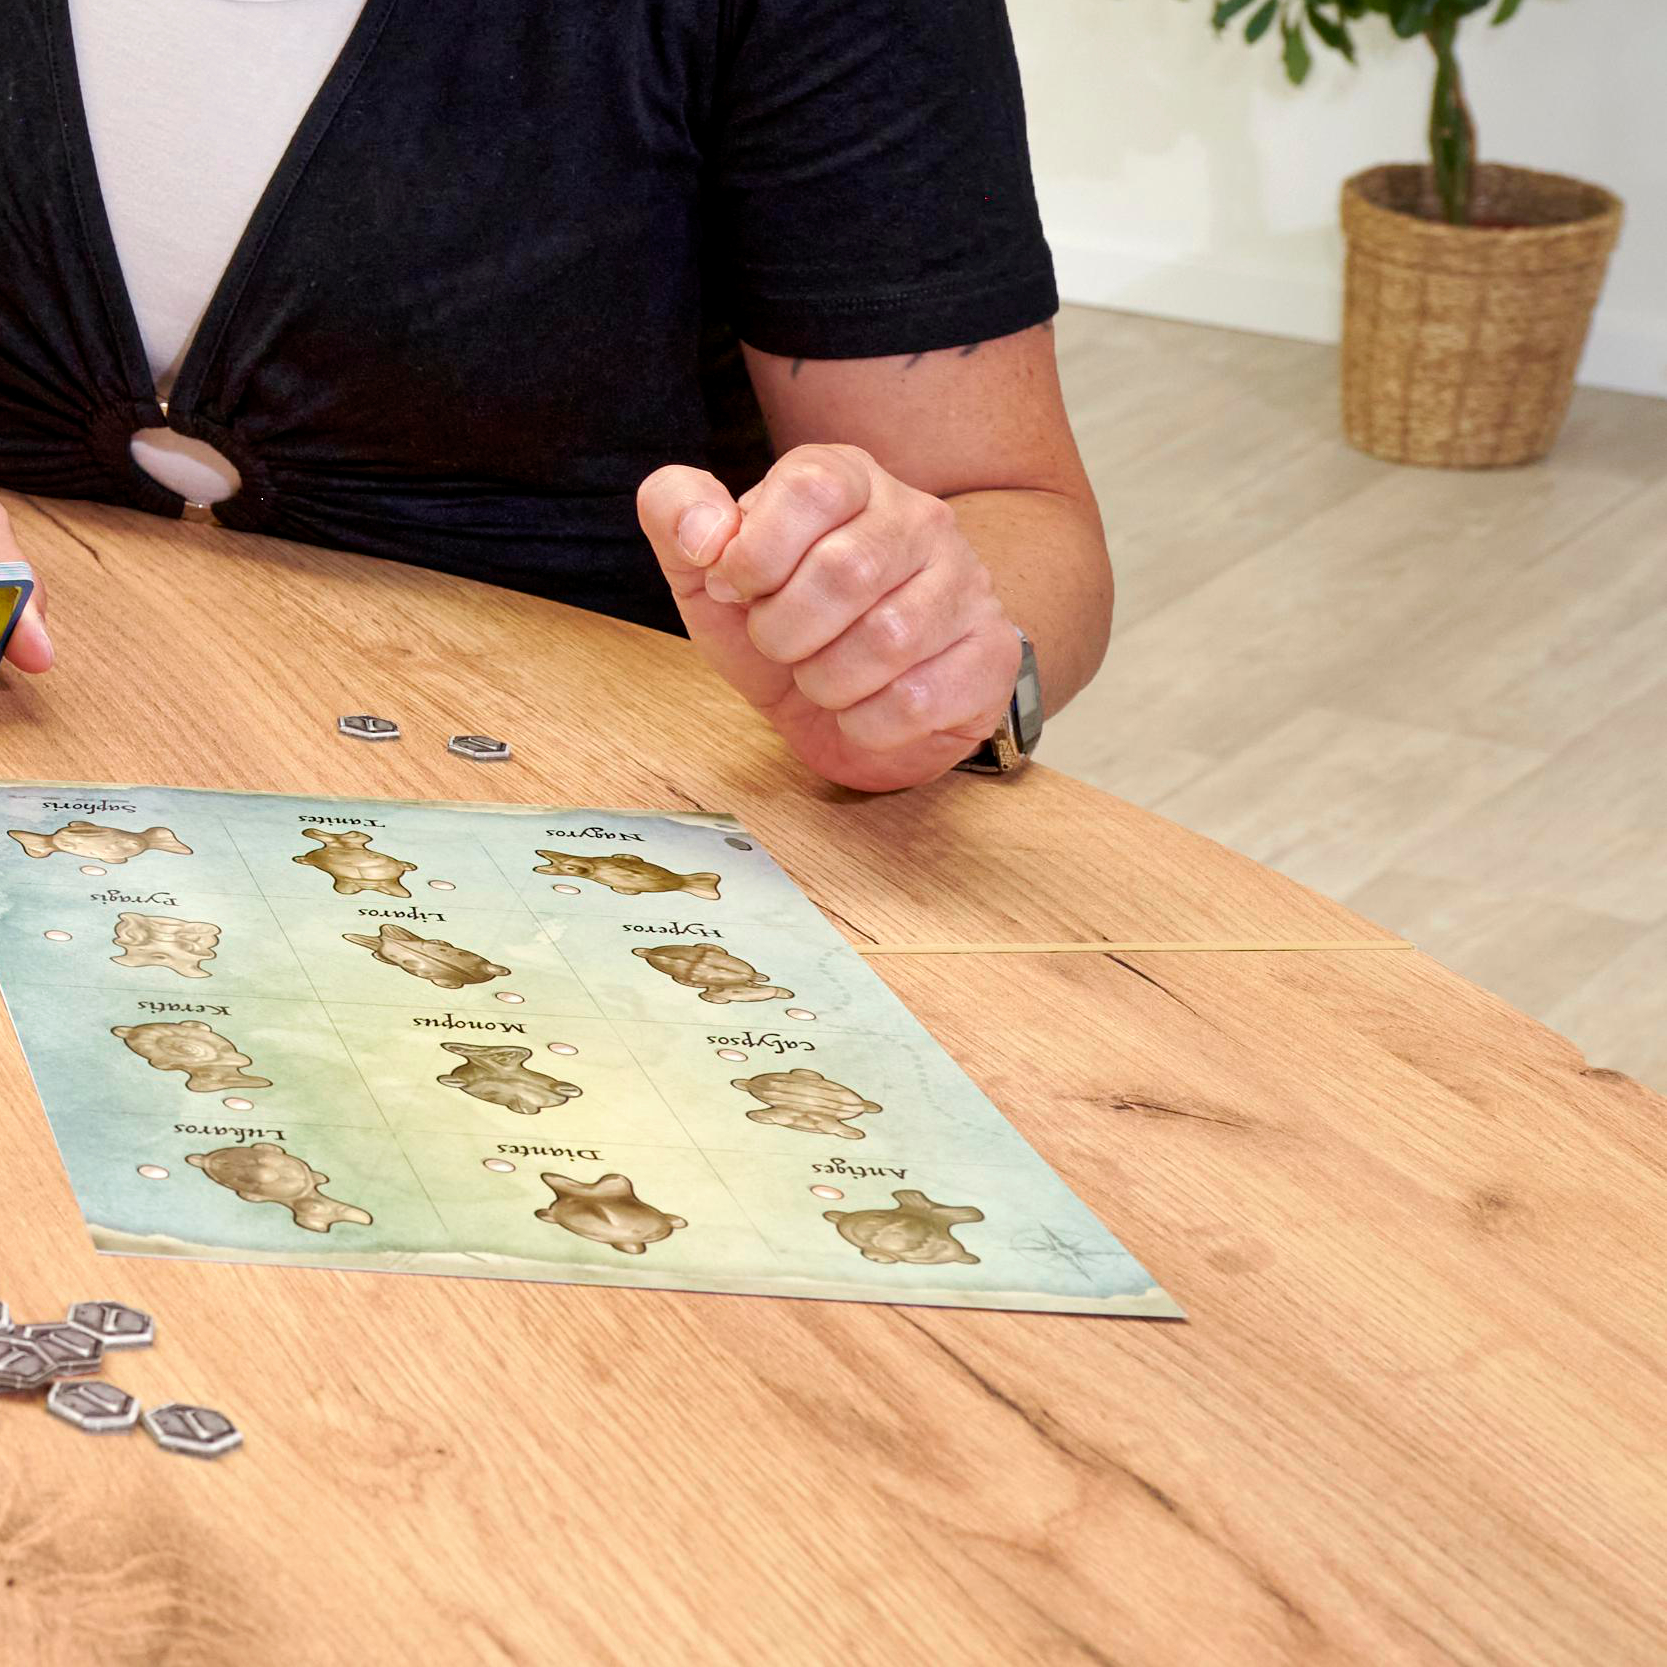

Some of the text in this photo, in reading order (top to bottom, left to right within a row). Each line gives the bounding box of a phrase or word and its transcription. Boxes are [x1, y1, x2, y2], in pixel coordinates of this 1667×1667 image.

[43, 799, 137, 814] Saphoris
[299, 814, 386, 829] Tanites
[546, 826, 645, 842] Nagyros
[91, 890, 179, 907] Pyragis
[358, 907, 446, 922] Liparos
[623, 922, 725, 939] Hyperos
[138, 1000, 232, 1016] Keratis
[413, 1013, 527, 1035] Monopus
[707, 1032, 815, 1053] Calypsos
[497, 1144, 604, 1161] Diantes
[812, 1158, 908, 1179] Antiges
